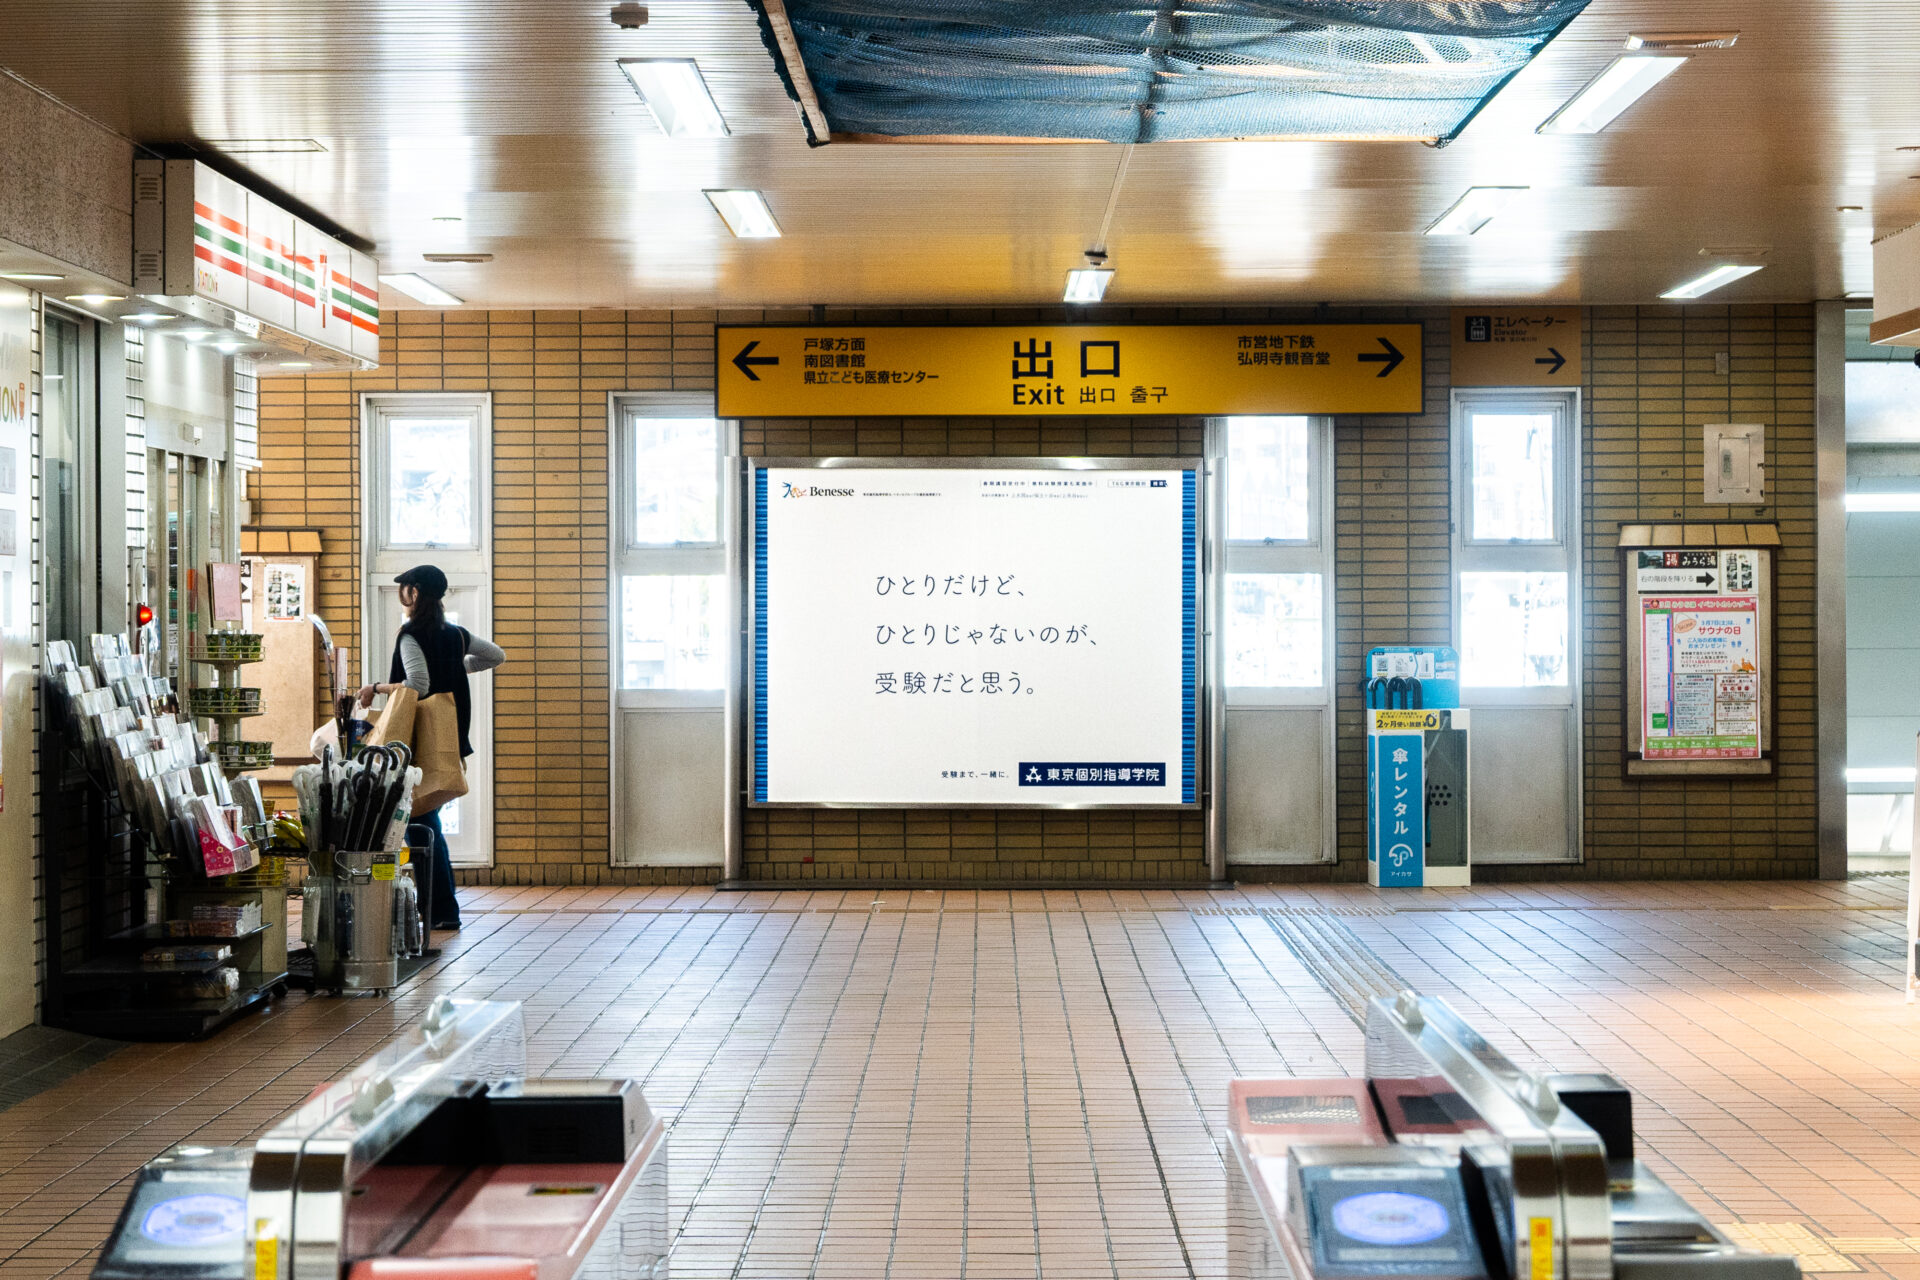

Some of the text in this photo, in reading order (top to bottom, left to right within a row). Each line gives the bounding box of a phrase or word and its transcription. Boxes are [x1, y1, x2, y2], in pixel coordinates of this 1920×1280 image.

[1494, 316, 1567, 328] エレベーター
[1494, 328, 1528, 336] Elevator
[804, 338, 865, 351] 戸塚方面
[1237, 335, 1316, 349] 市営地下鉄
[804, 354, 865, 368] 南図書館
[1012, 338, 1120, 379] 出口
[1237, 351, 1330, 366] 弘明寺観音堂
[803, 370, 939, 385] 県立こども医療センター
[1013, 384, 1065, 405] Exit
[1080, 387, 1116, 403] 出口
[1130, 385, 1169, 404] 출구
[810, 486, 855, 497] Benesse
[876, 574, 1024, 597] ひとりだけど、
[876, 623, 1096, 646] ひとりじゃないのが、
[1698, 626, 1741, 635] サウナの日
[875, 671, 1034, 695] 受験だと思う。
[1047, 767, 1160, 782] 東京個別指導学院
[1392, 748, 1409, 835] 傘レンタル
